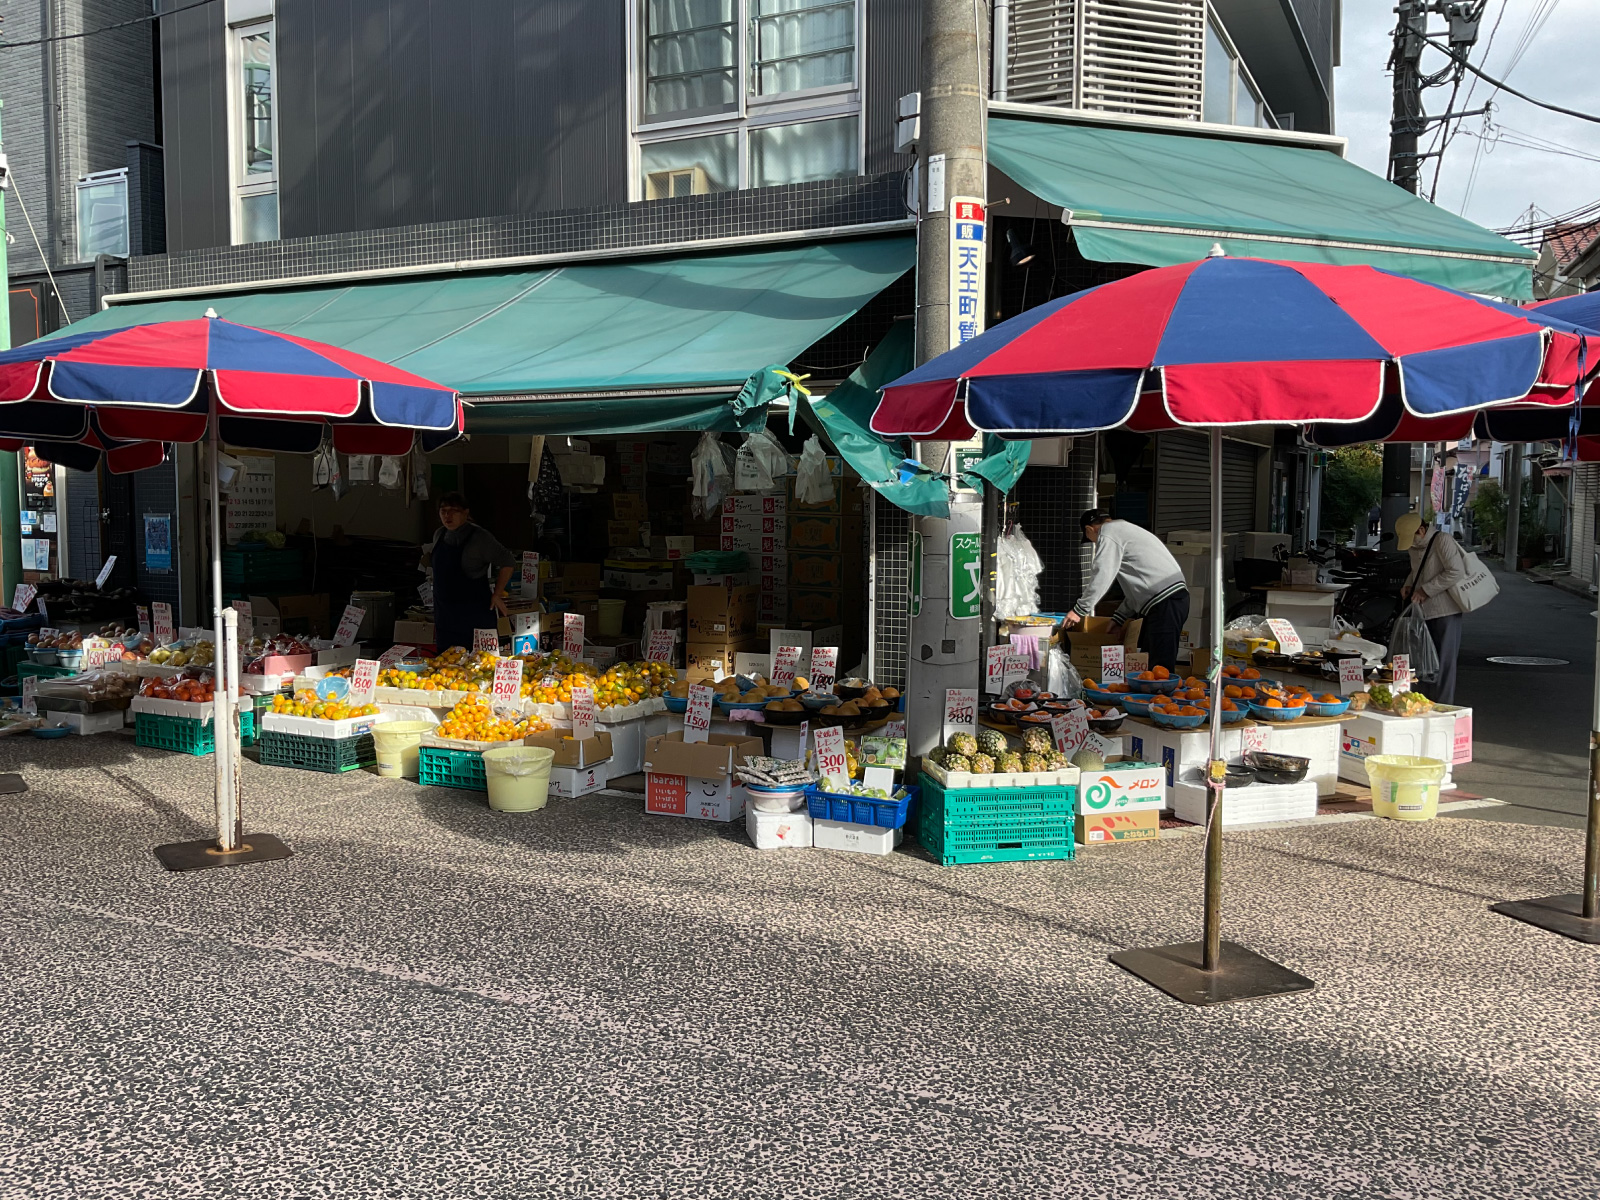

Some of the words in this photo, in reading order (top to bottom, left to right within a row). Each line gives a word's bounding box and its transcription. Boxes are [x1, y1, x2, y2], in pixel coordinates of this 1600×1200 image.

[961, 204, 974, 218] 買
[961, 224, 974, 240] 販
[523, 573, 537, 582] 580
[1460, 573, 1487, 593] BOTANICAL
[155, 625, 171, 635] 1000
[1279, 635, 1299, 643] 1000
[565, 642, 582, 653] 1000
[90, 651, 104, 665] 680
[648, 651, 669, 660] 1000
[1127, 662, 1148, 672] 580
[772, 670, 795, 680] 1000
[354, 677, 373, 689] 800
[494, 682, 518, 696] 800
[687, 715, 709, 729] 1500
[948, 712, 973, 723] 280
[817, 738, 841, 749] レモン
[819, 753, 845, 769] 300
[826, 766, 841, 776] 円
[650, 774, 683, 787] Ibaraki
[1128, 778, 1160, 790] メロン
[701, 808, 719, 819] なし
